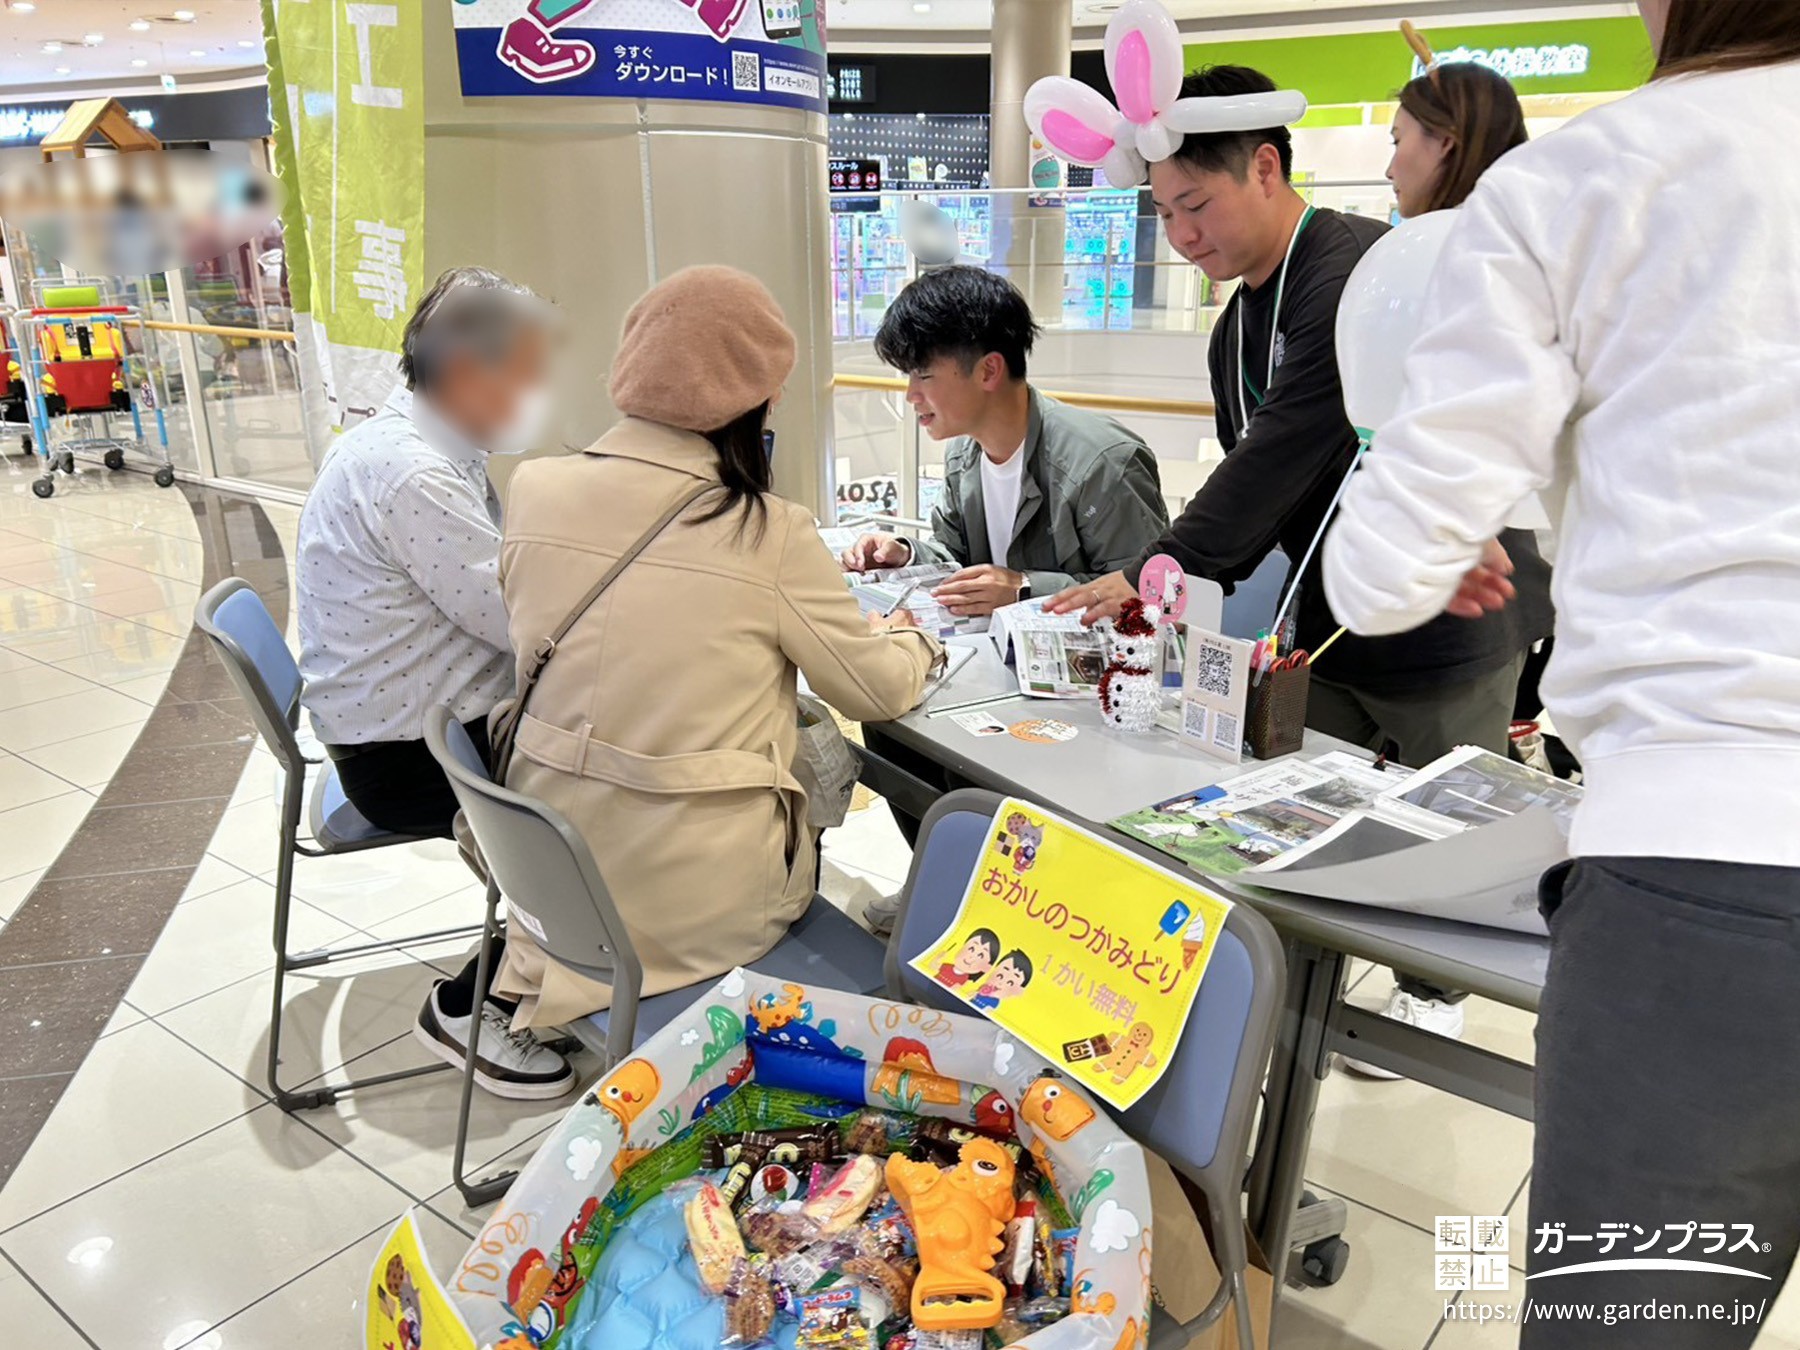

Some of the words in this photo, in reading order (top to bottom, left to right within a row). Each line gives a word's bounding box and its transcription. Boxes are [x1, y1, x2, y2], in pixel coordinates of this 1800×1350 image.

[613, 45, 654, 60] 今すぐ
[615, 62, 729, 86] ダウンロード！
[981, 867, 1182, 994] おかしのつかみどり
